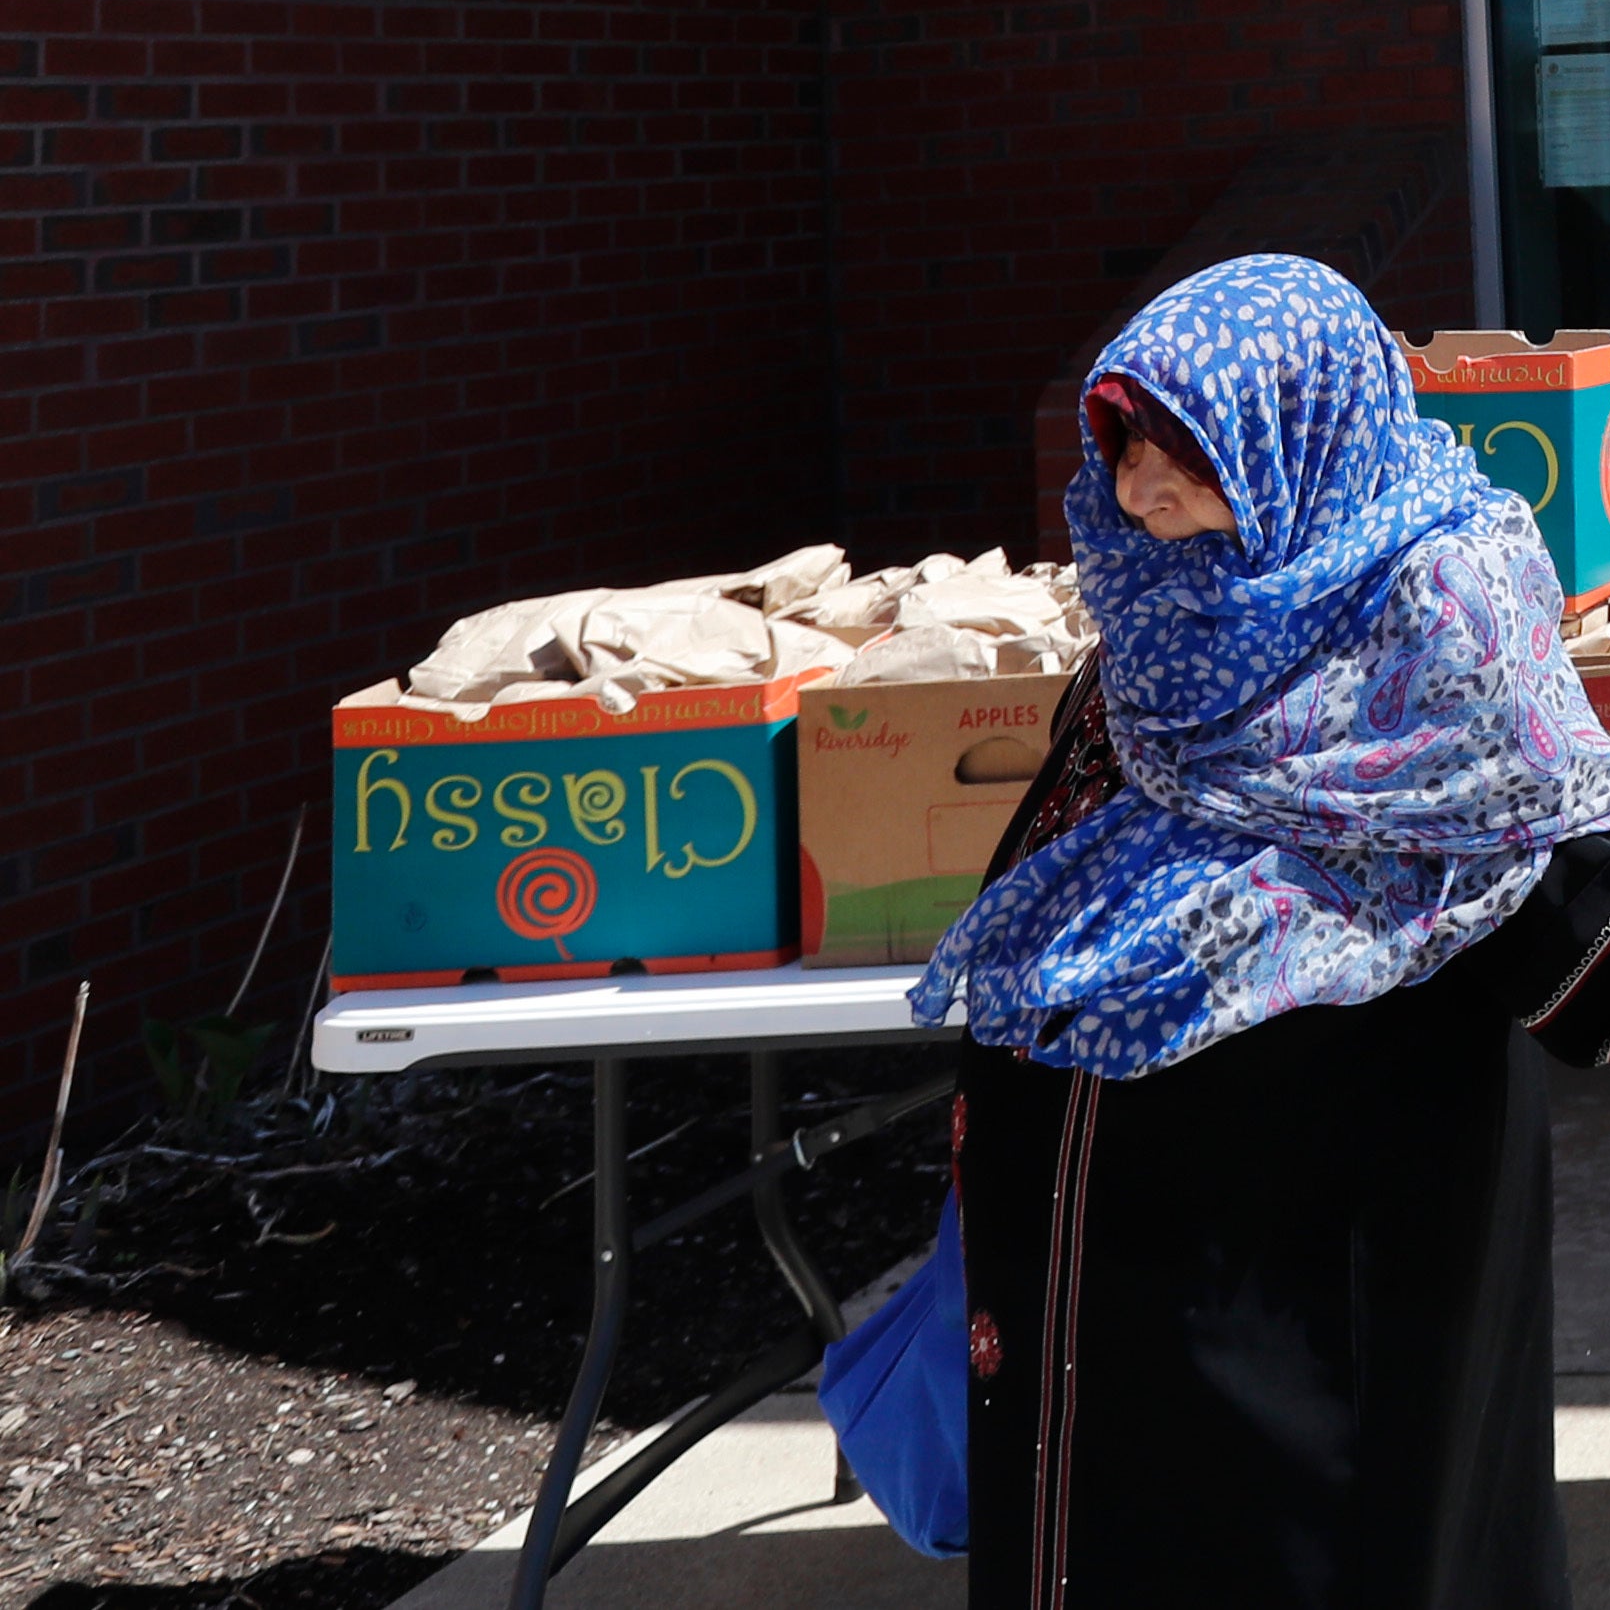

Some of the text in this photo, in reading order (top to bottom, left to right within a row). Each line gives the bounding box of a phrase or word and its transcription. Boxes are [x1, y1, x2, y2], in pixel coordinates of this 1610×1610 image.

[1436, 361, 1567, 389] Premium
[612, 692, 765, 726] Premium
[958, 704, 1040, 729] APPLES
[341, 716, 434, 744] Citrus
[815, 721, 912, 759] Riveridge
[353, 748, 758, 879] Classy
